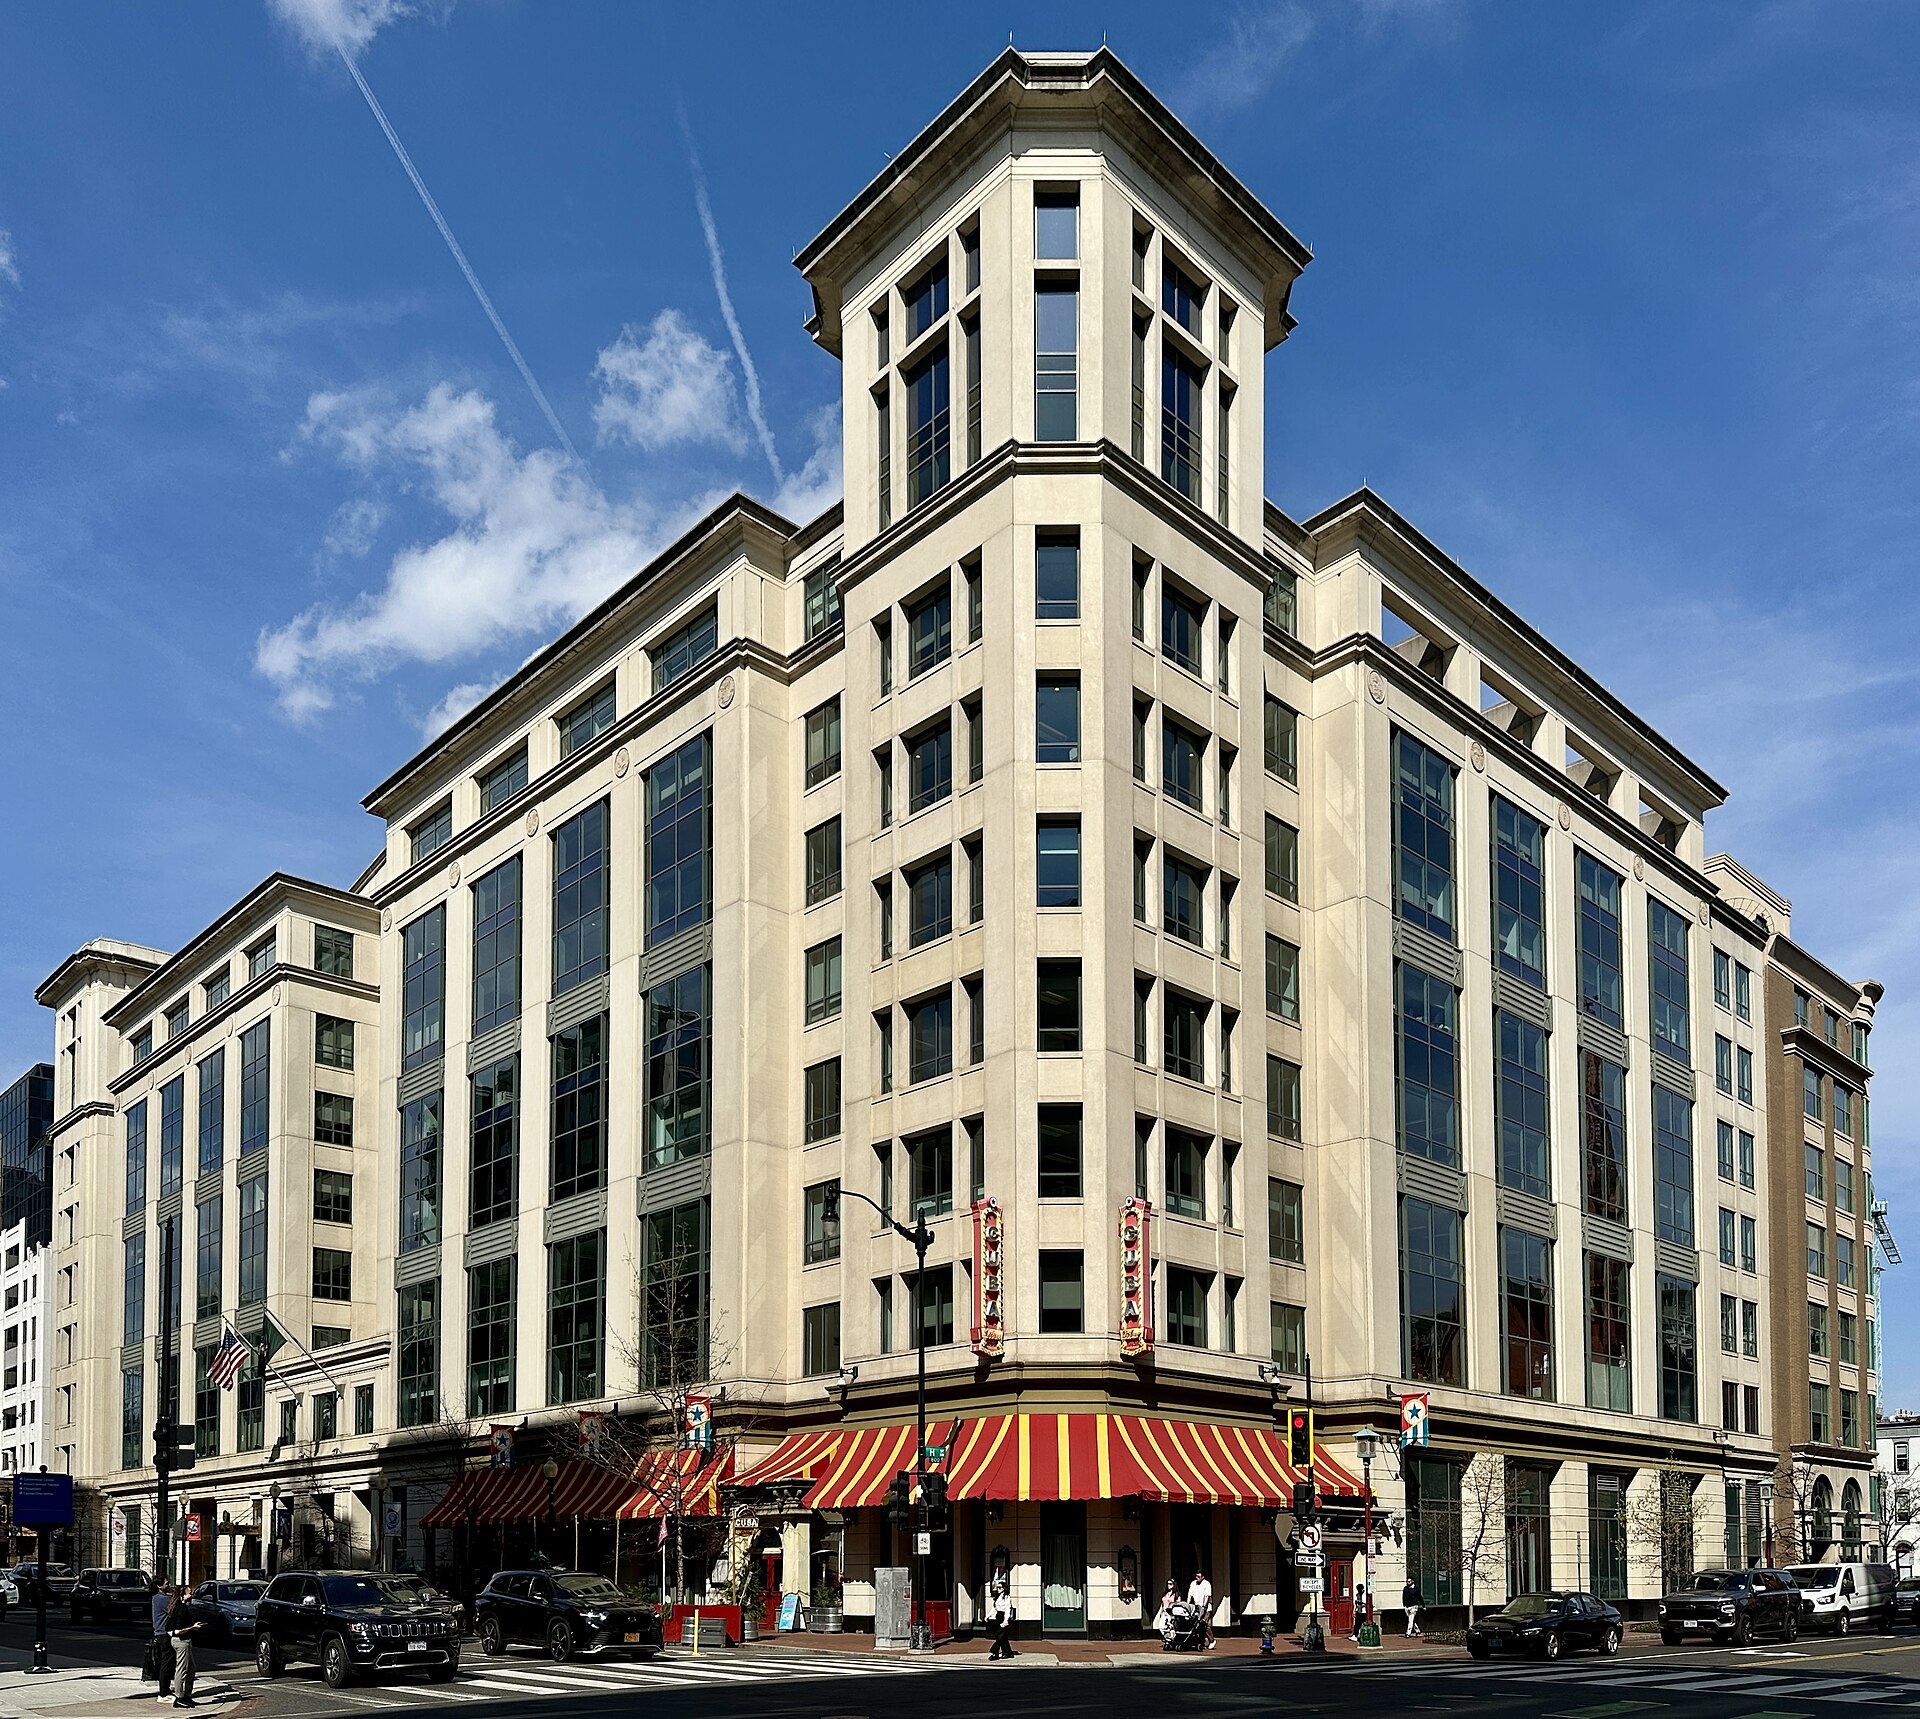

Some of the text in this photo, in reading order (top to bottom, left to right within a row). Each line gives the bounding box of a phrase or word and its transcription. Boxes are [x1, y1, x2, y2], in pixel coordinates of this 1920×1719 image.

[985, 1225, 1001, 1318] CUBA
[1123, 1225, 1139, 1317] CUBA
[929, 1448, 935, 1457] H
[735, 1518, 758, 1528] CUBA
